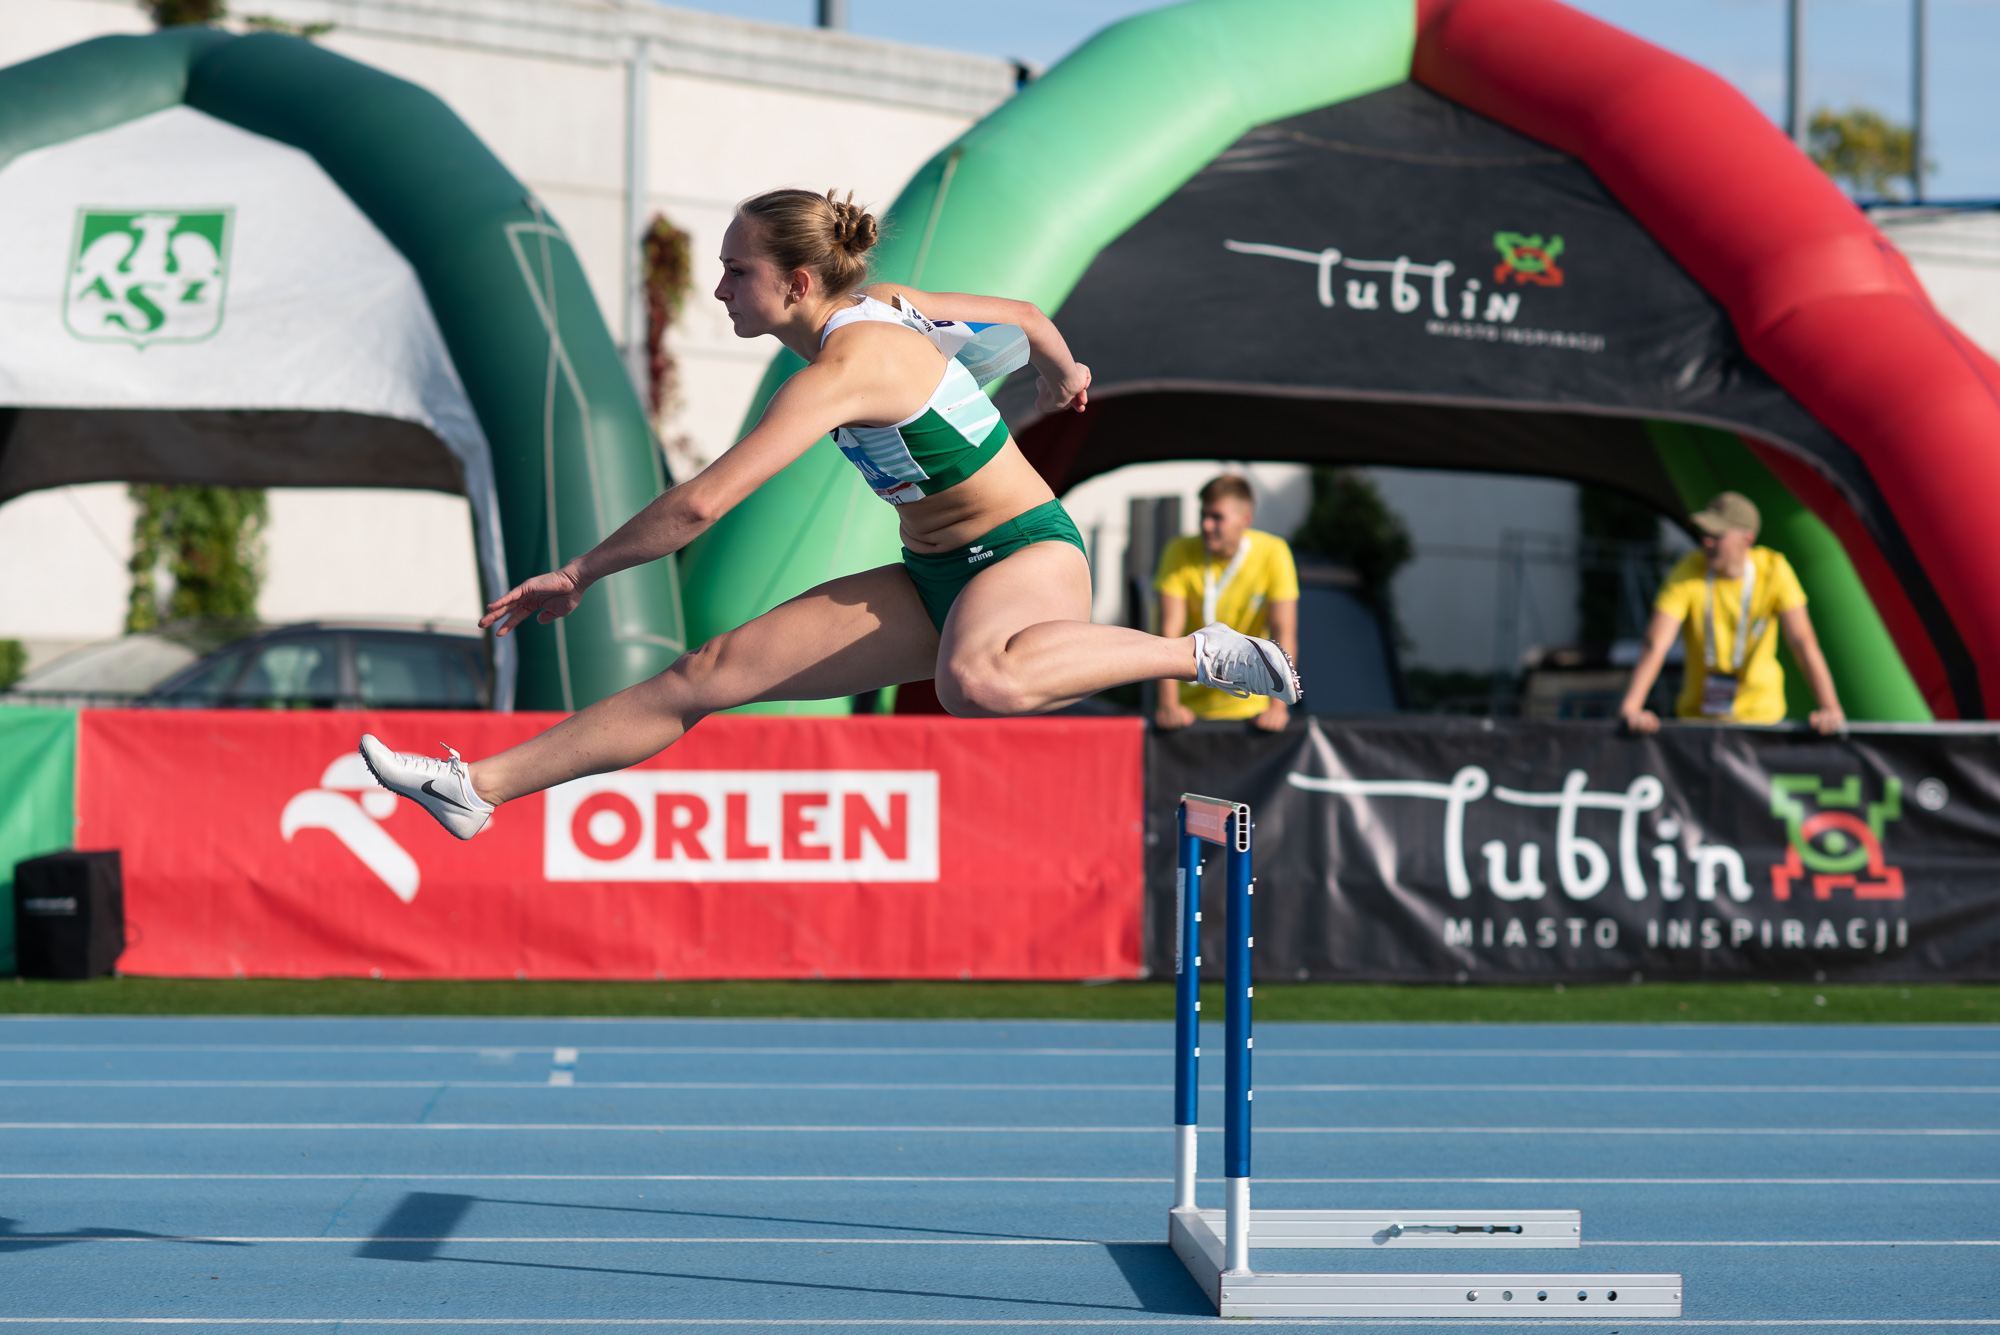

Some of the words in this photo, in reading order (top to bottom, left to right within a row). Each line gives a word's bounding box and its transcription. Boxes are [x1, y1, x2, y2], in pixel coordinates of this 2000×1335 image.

[968, 550, 994, 564] erima
[570, 790, 908, 863] ORLEN
[1443, 917, 1619, 949] MIASTO
[1646, 917, 1909, 953] INSPIRACJI
